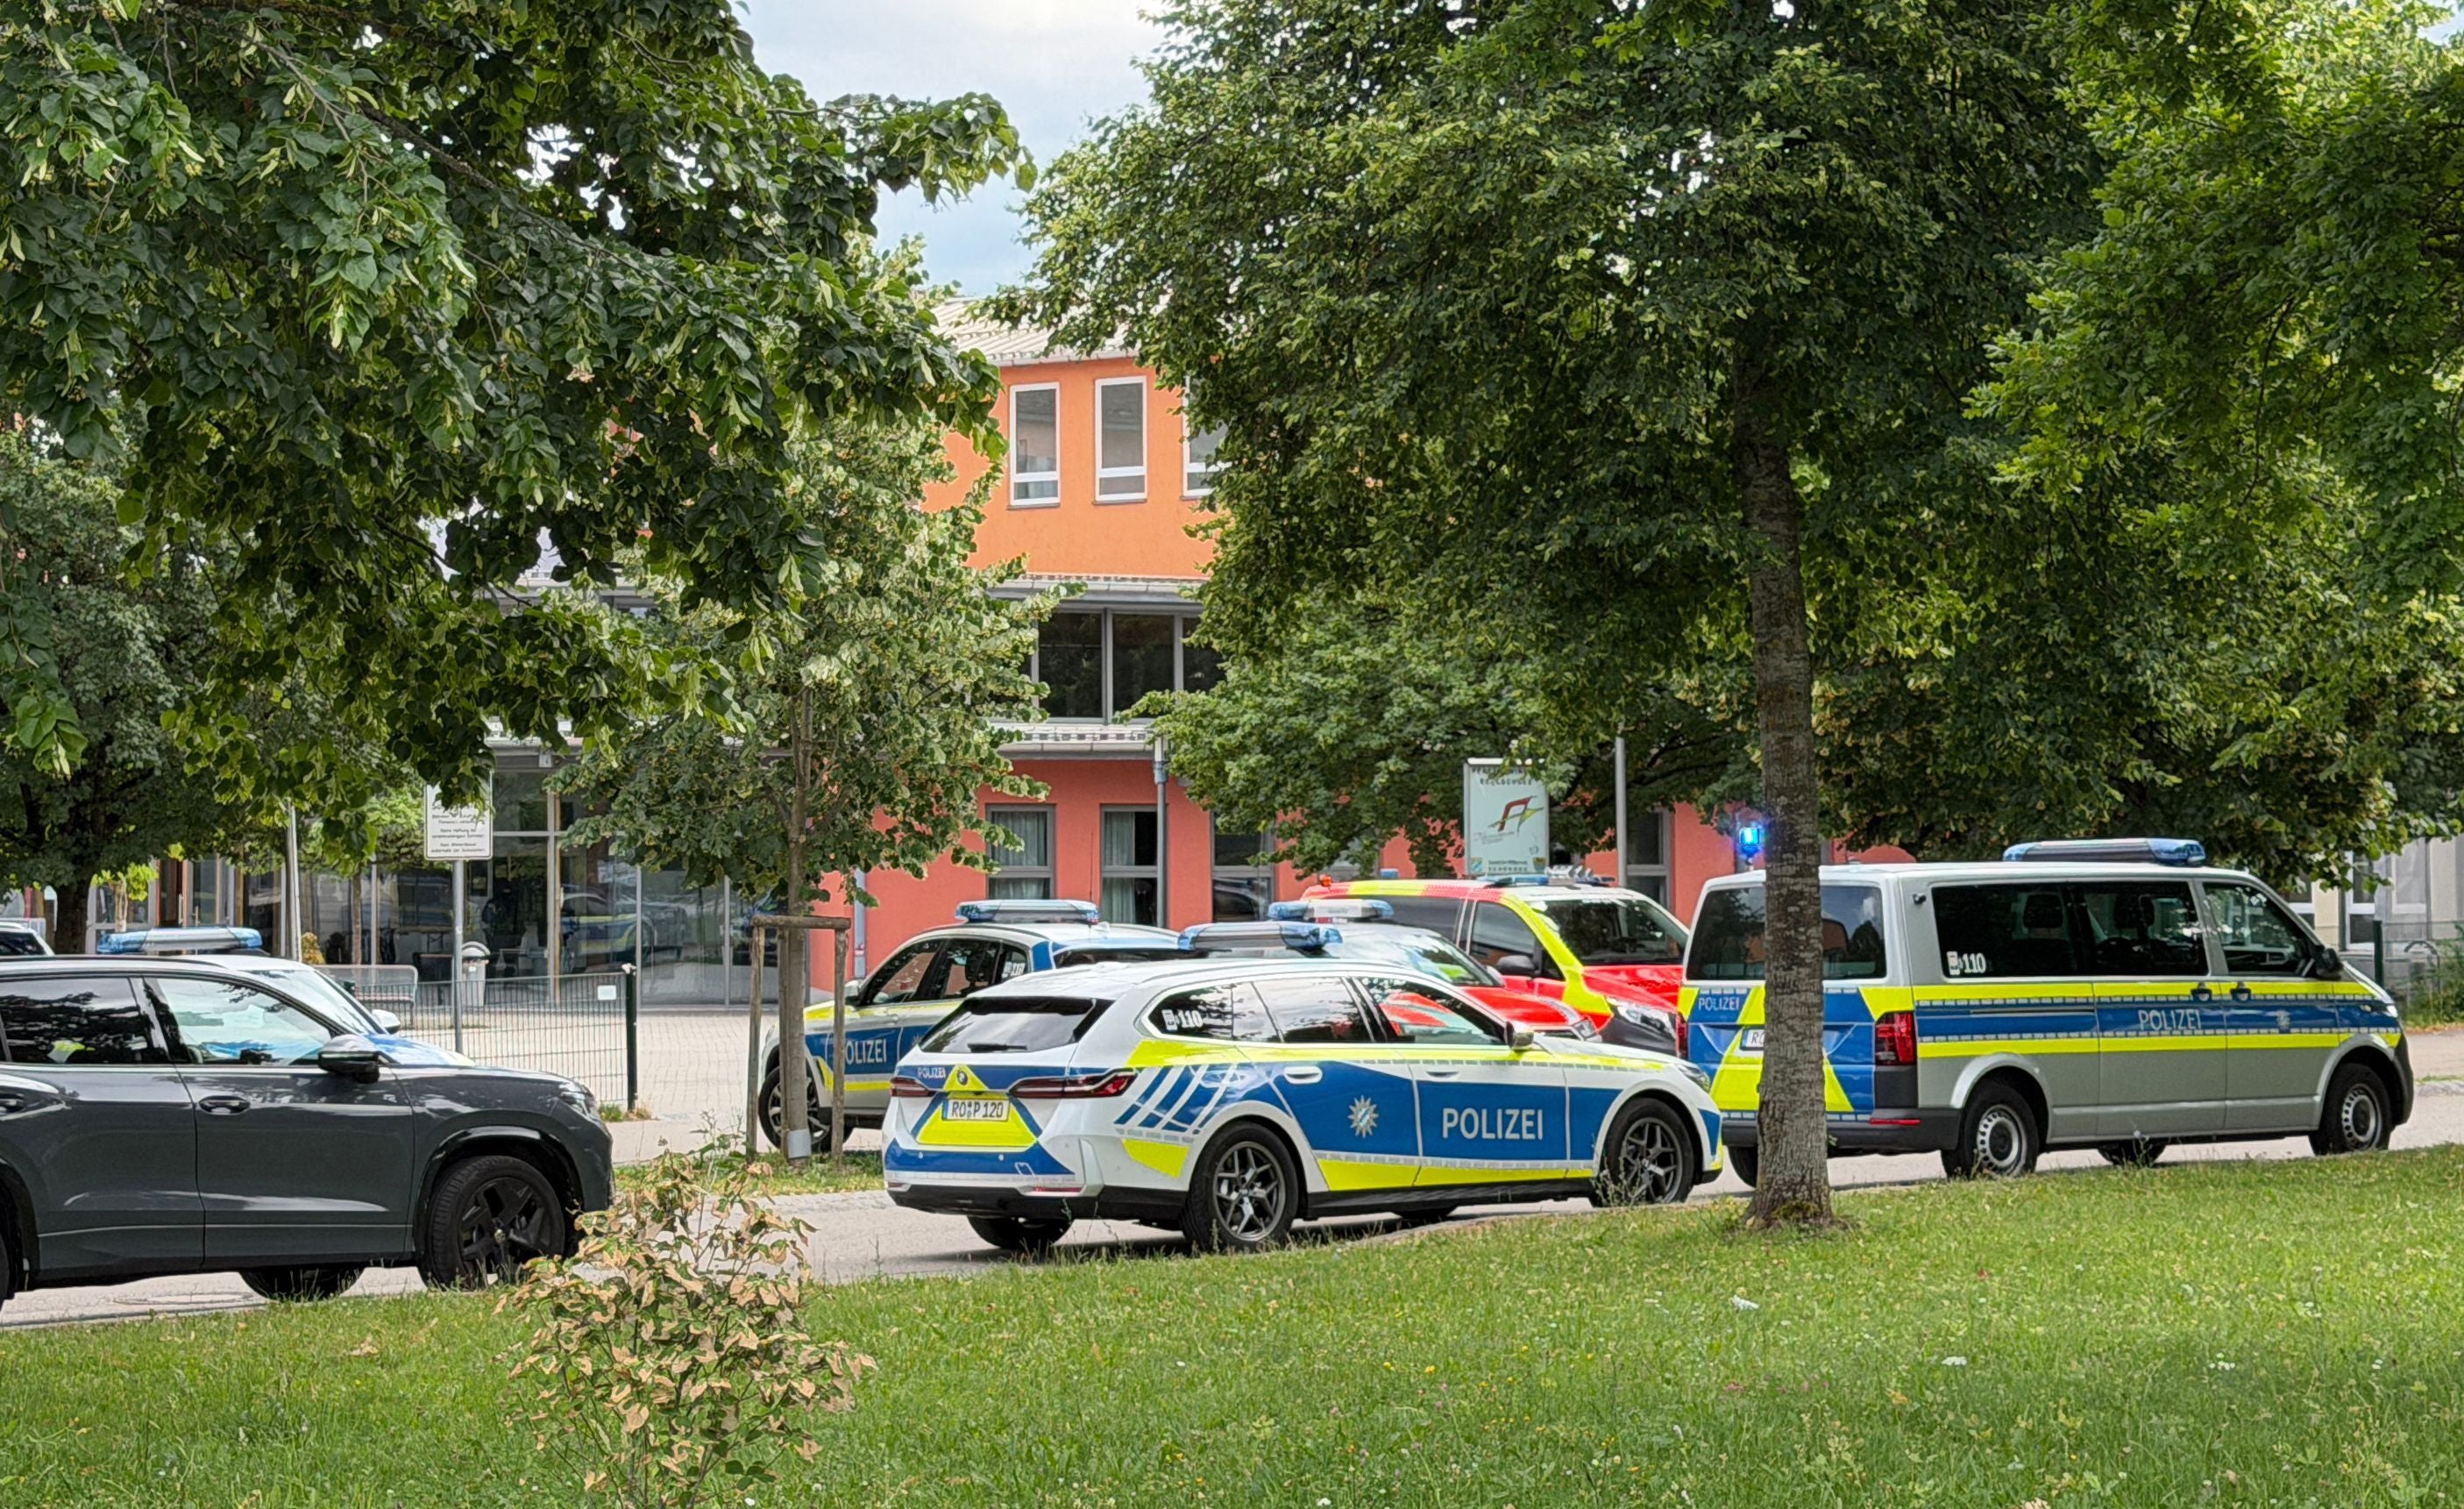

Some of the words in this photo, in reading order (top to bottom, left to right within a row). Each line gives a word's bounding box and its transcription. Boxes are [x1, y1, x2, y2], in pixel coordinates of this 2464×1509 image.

[1963, 952, 1986, 973] 110
[1698, 996, 1740, 1011] POLIZEI
[1177, 1009, 1203, 1028] 110
[2138, 1009, 2201, 1031] POLIZEI
[845, 1038, 887, 1065] OLIZEI
[917, 1067, 946, 1078] POLIZEI
[951, 1101, 967, 1118] RO
[973, 1101, 982, 1117] P
[982, 1101, 1005, 1119] 120
[1442, 1107, 1544, 1140] POLIZEI
